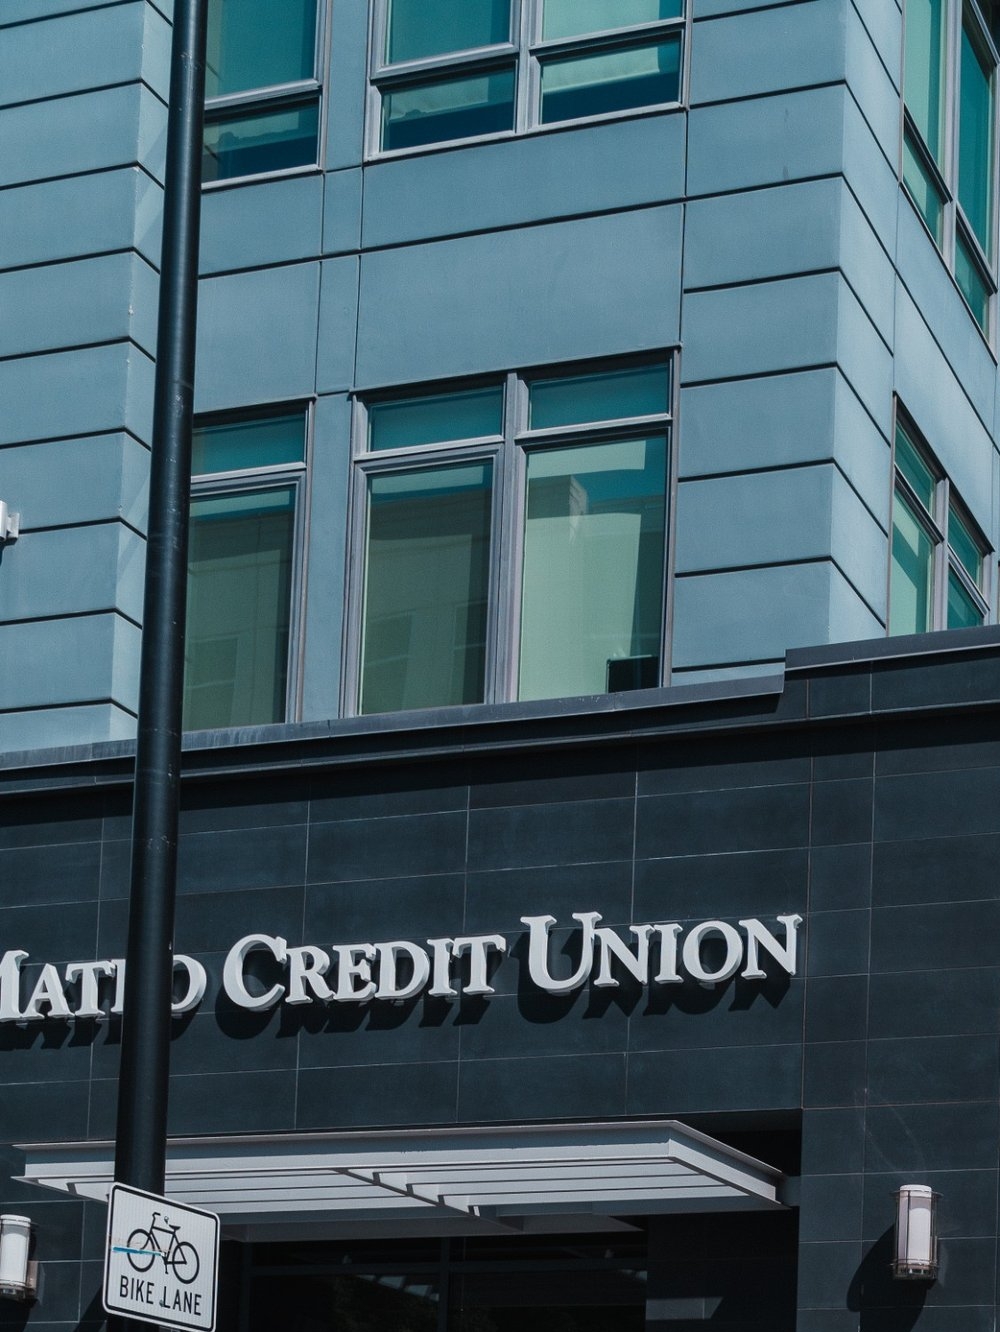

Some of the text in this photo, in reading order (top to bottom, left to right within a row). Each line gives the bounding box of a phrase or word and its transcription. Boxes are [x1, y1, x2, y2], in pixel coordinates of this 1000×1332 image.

[223, 934, 506, 1010] CREDIT
[520, 911, 803, 992] UNION
[120, 1275, 202, 1316] BIKE LANE
